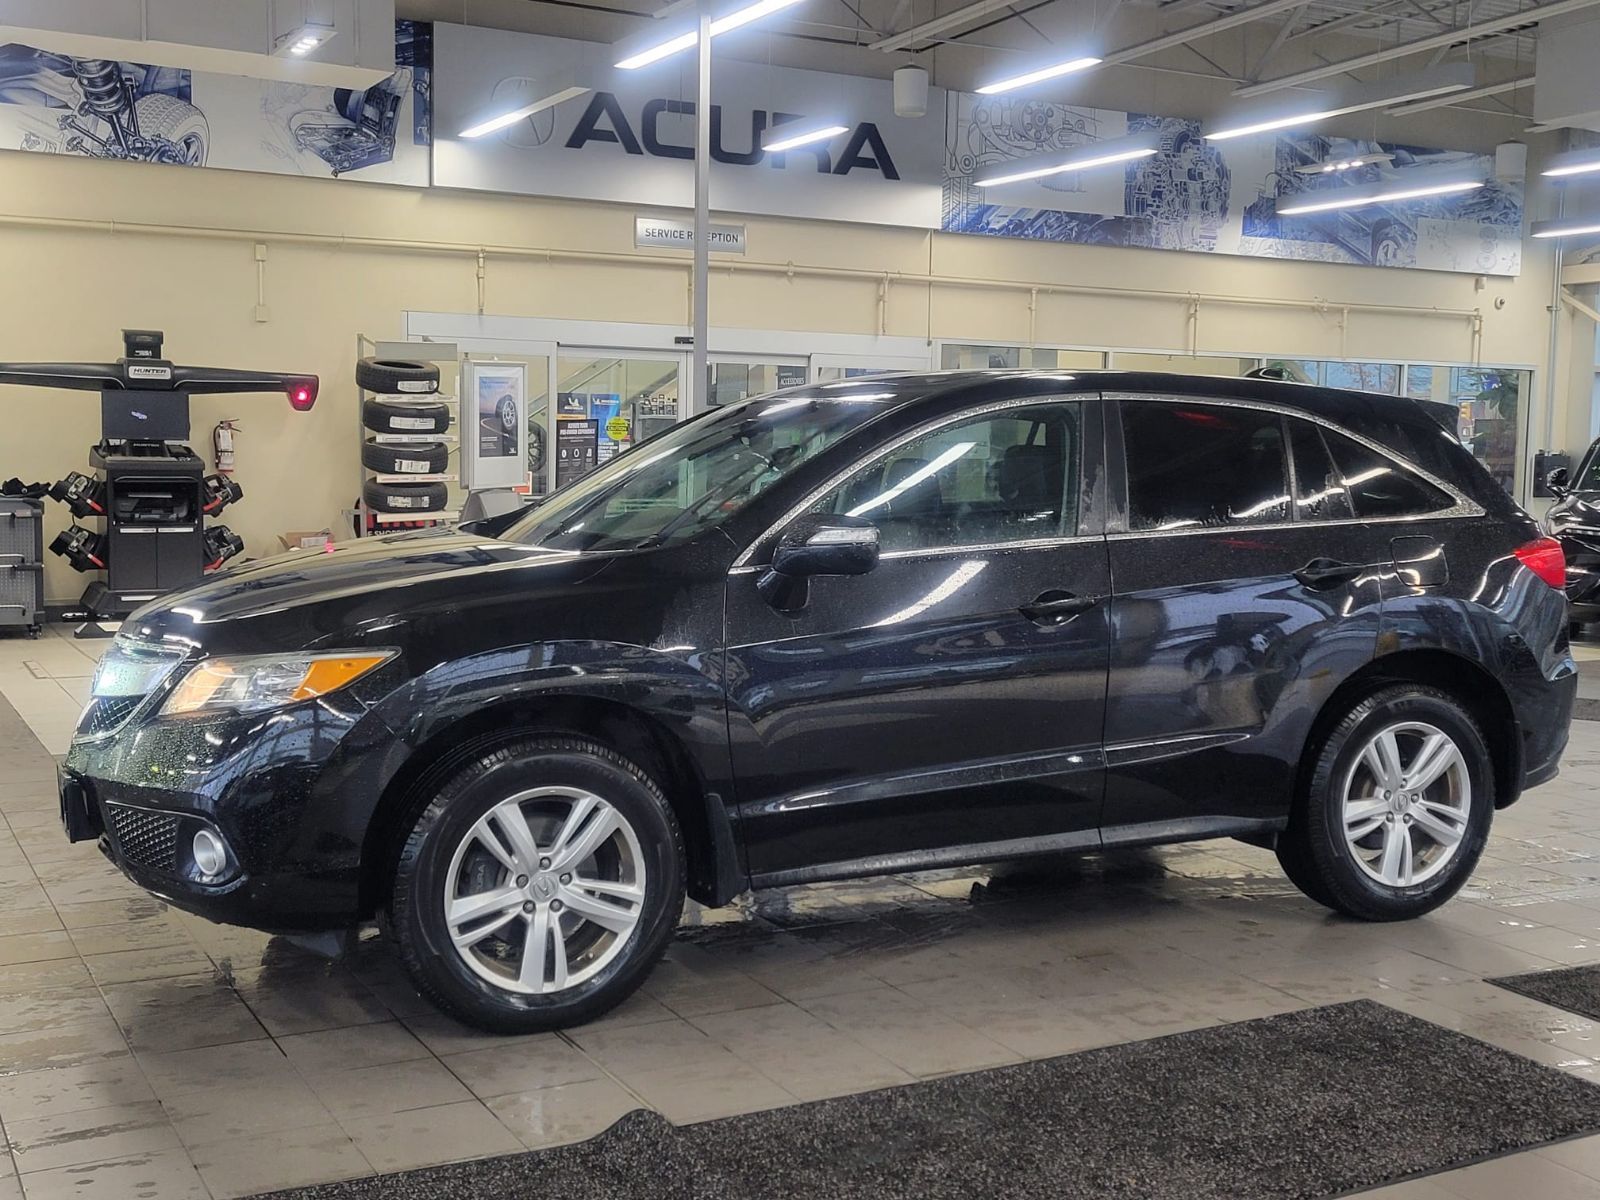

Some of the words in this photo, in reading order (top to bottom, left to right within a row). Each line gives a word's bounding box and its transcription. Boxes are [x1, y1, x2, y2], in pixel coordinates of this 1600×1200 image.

[564, 91, 900, 180] ACURA
[645, 228, 685, 239] SERVICE
[687, 231, 739, 243] REPTION
